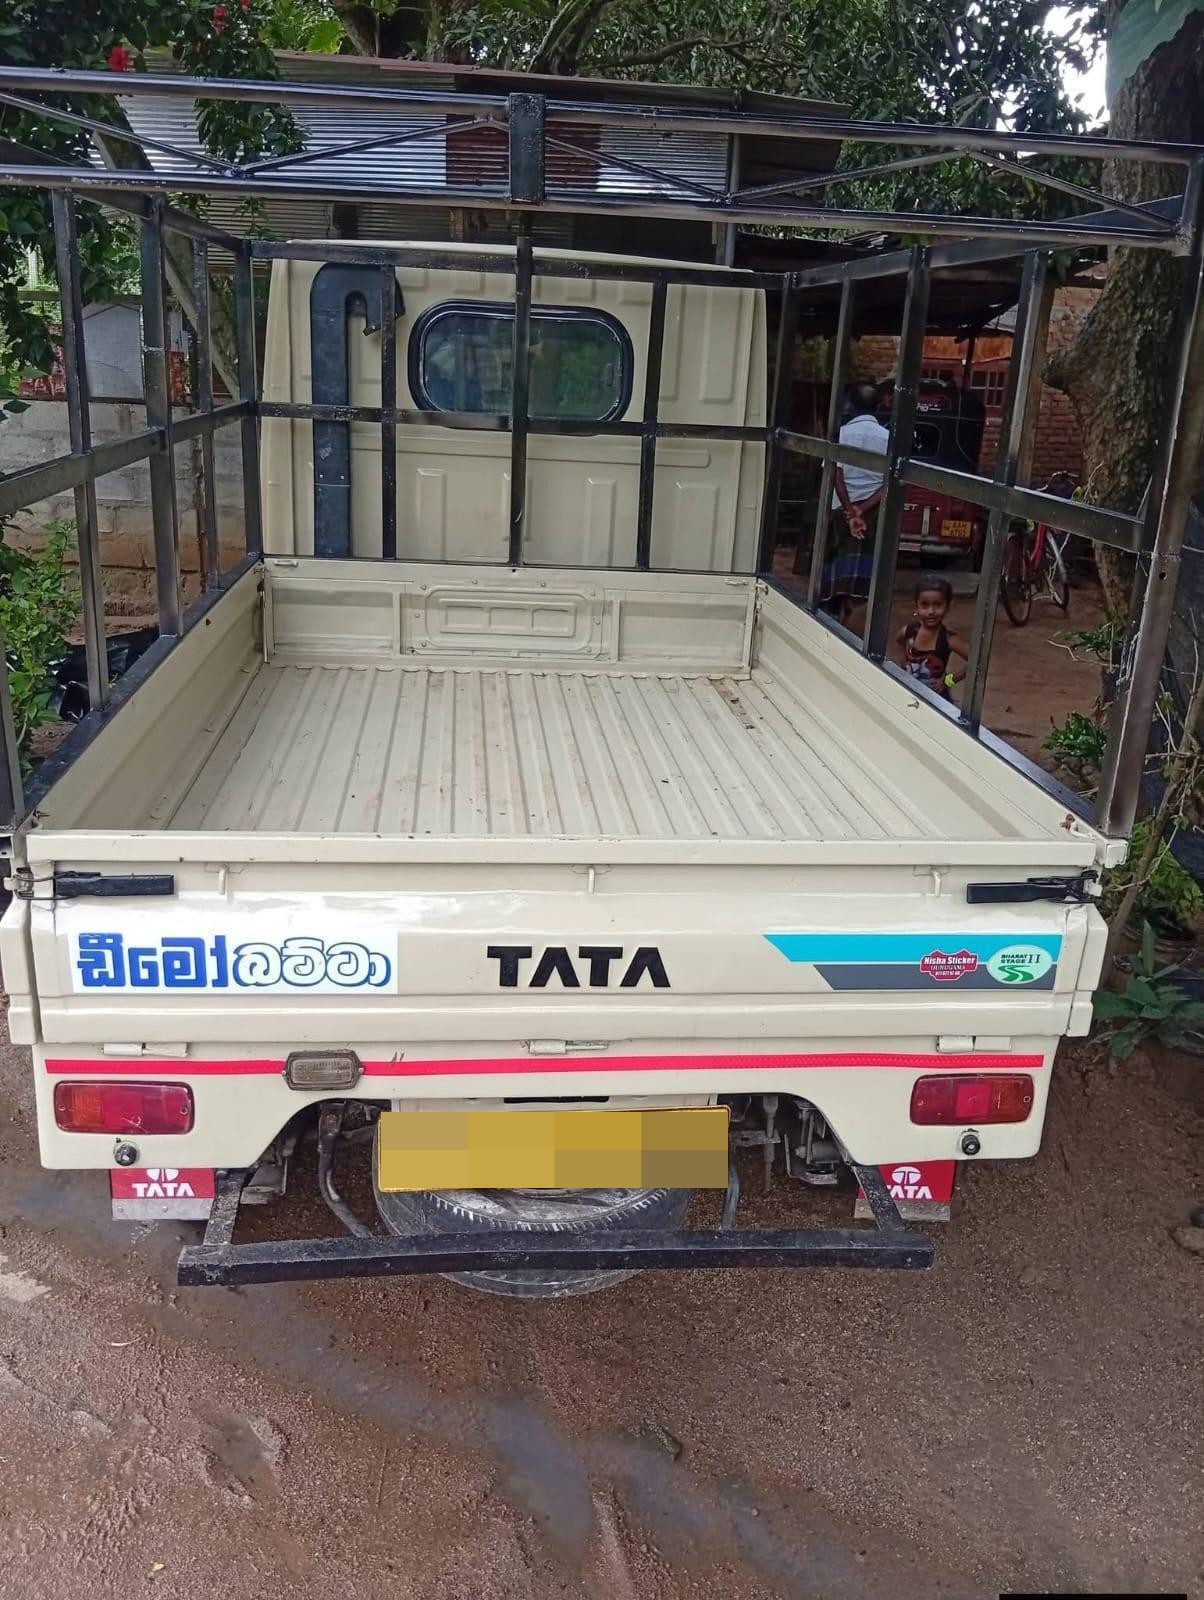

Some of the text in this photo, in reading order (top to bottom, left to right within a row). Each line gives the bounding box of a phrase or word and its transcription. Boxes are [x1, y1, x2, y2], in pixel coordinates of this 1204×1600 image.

[486, 945, 672, 988] TATA
[924, 956, 975, 965] Nisha Sticker
[131, 1182, 196, 1198] TATA
[886, 1184, 933, 1200] ATA
